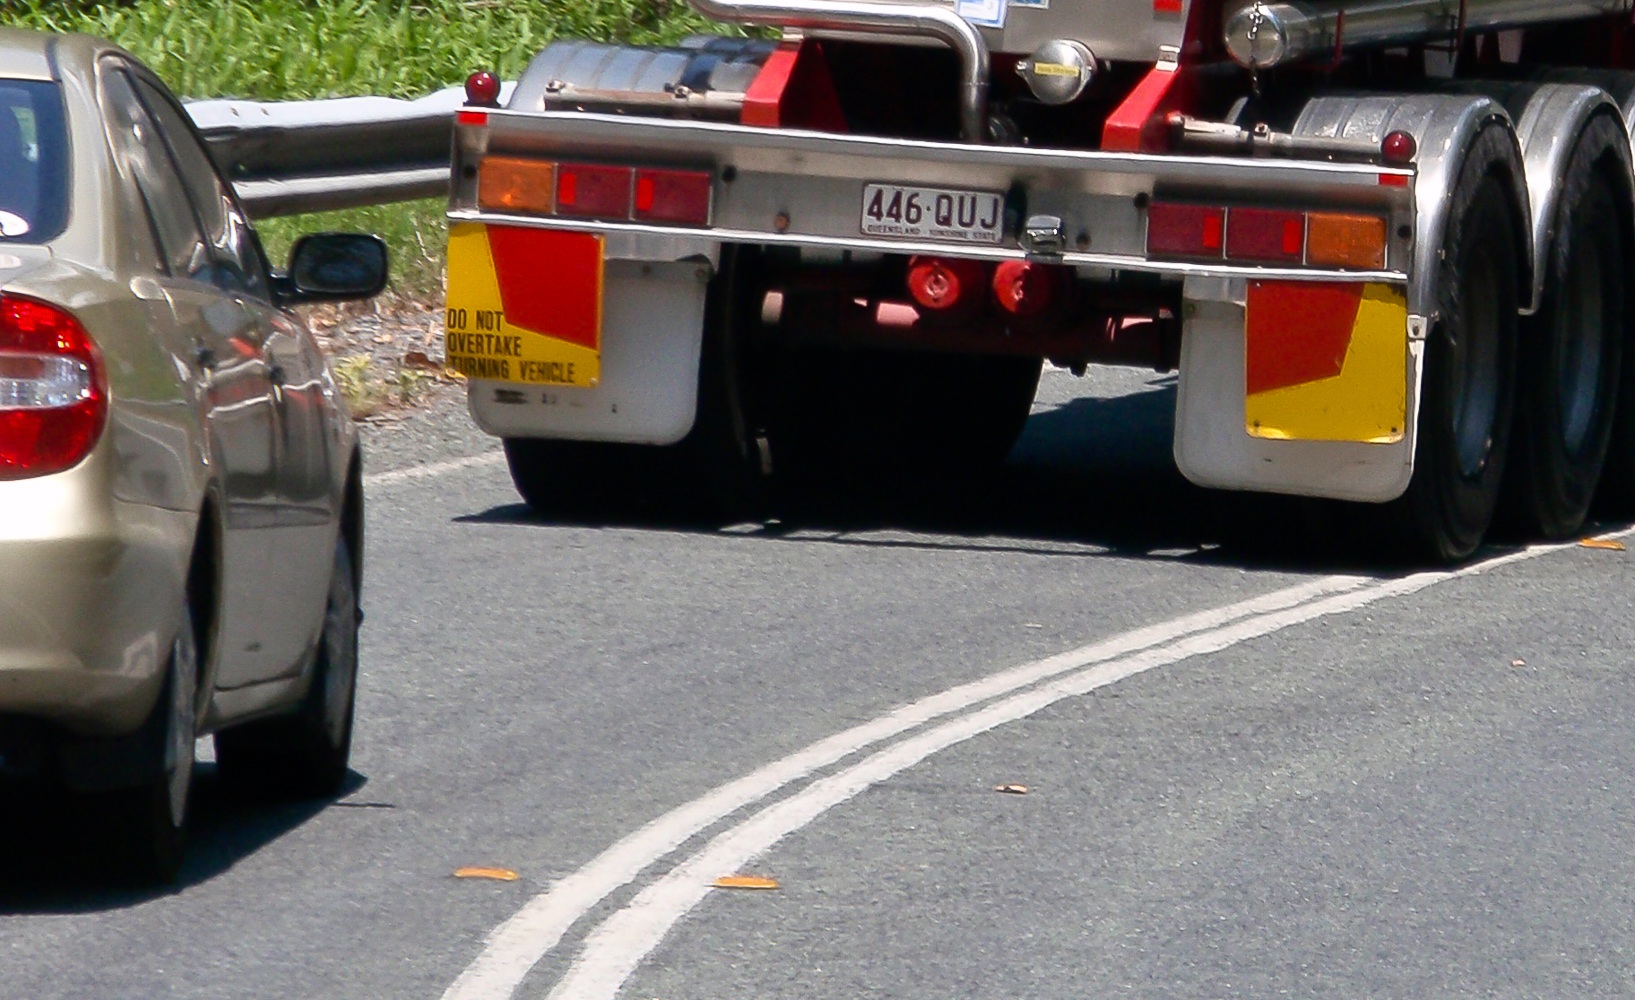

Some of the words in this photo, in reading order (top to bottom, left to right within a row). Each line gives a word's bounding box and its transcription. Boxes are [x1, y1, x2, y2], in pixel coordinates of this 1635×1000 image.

[447, 308, 467, 329] DO
[476, 310, 503, 331] NOT
[447, 332, 522, 357] OVERTAKE
[449, 355, 510, 379] TURNING
[519, 360, 576, 384] VEHICLE
